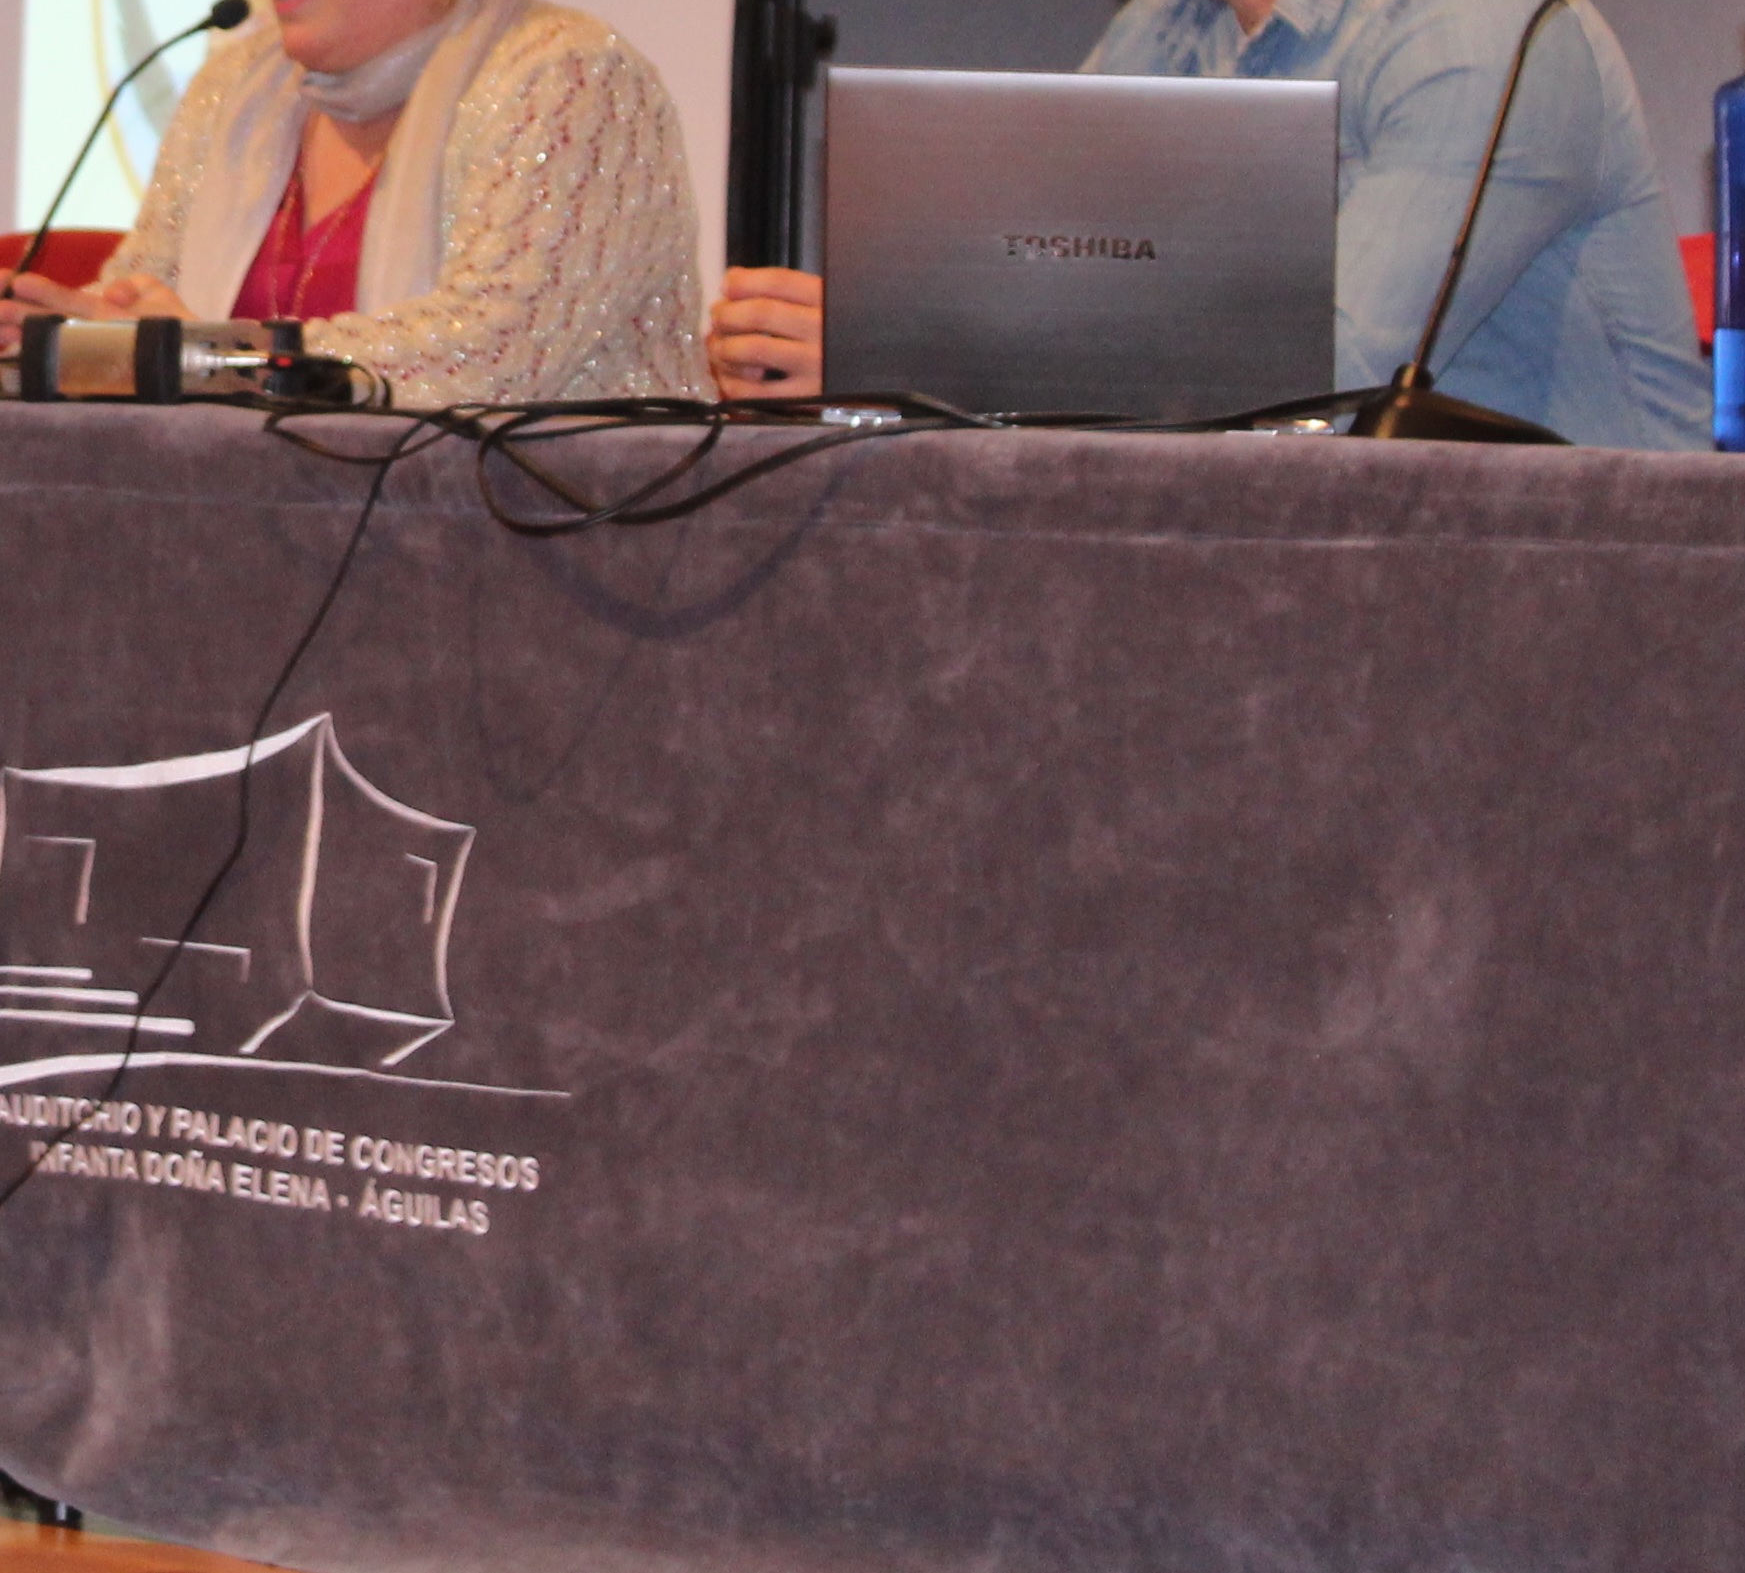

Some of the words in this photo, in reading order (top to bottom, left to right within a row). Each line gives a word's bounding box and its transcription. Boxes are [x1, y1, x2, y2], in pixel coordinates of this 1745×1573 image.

[1004, 235, 1156, 260] TOSHIBA
[144, 1104, 167, 1137] Y
[169, 1106, 299, 1159] PALACIO
[303, 1127, 346, 1166] DE
[349, 1135, 541, 1192] CONGRESOS
[141, 1149, 227, 1194] DOÑA
[229, 1161, 332, 1212] ELENA
[359, 1178, 491, 1236] ÁGUILAS
